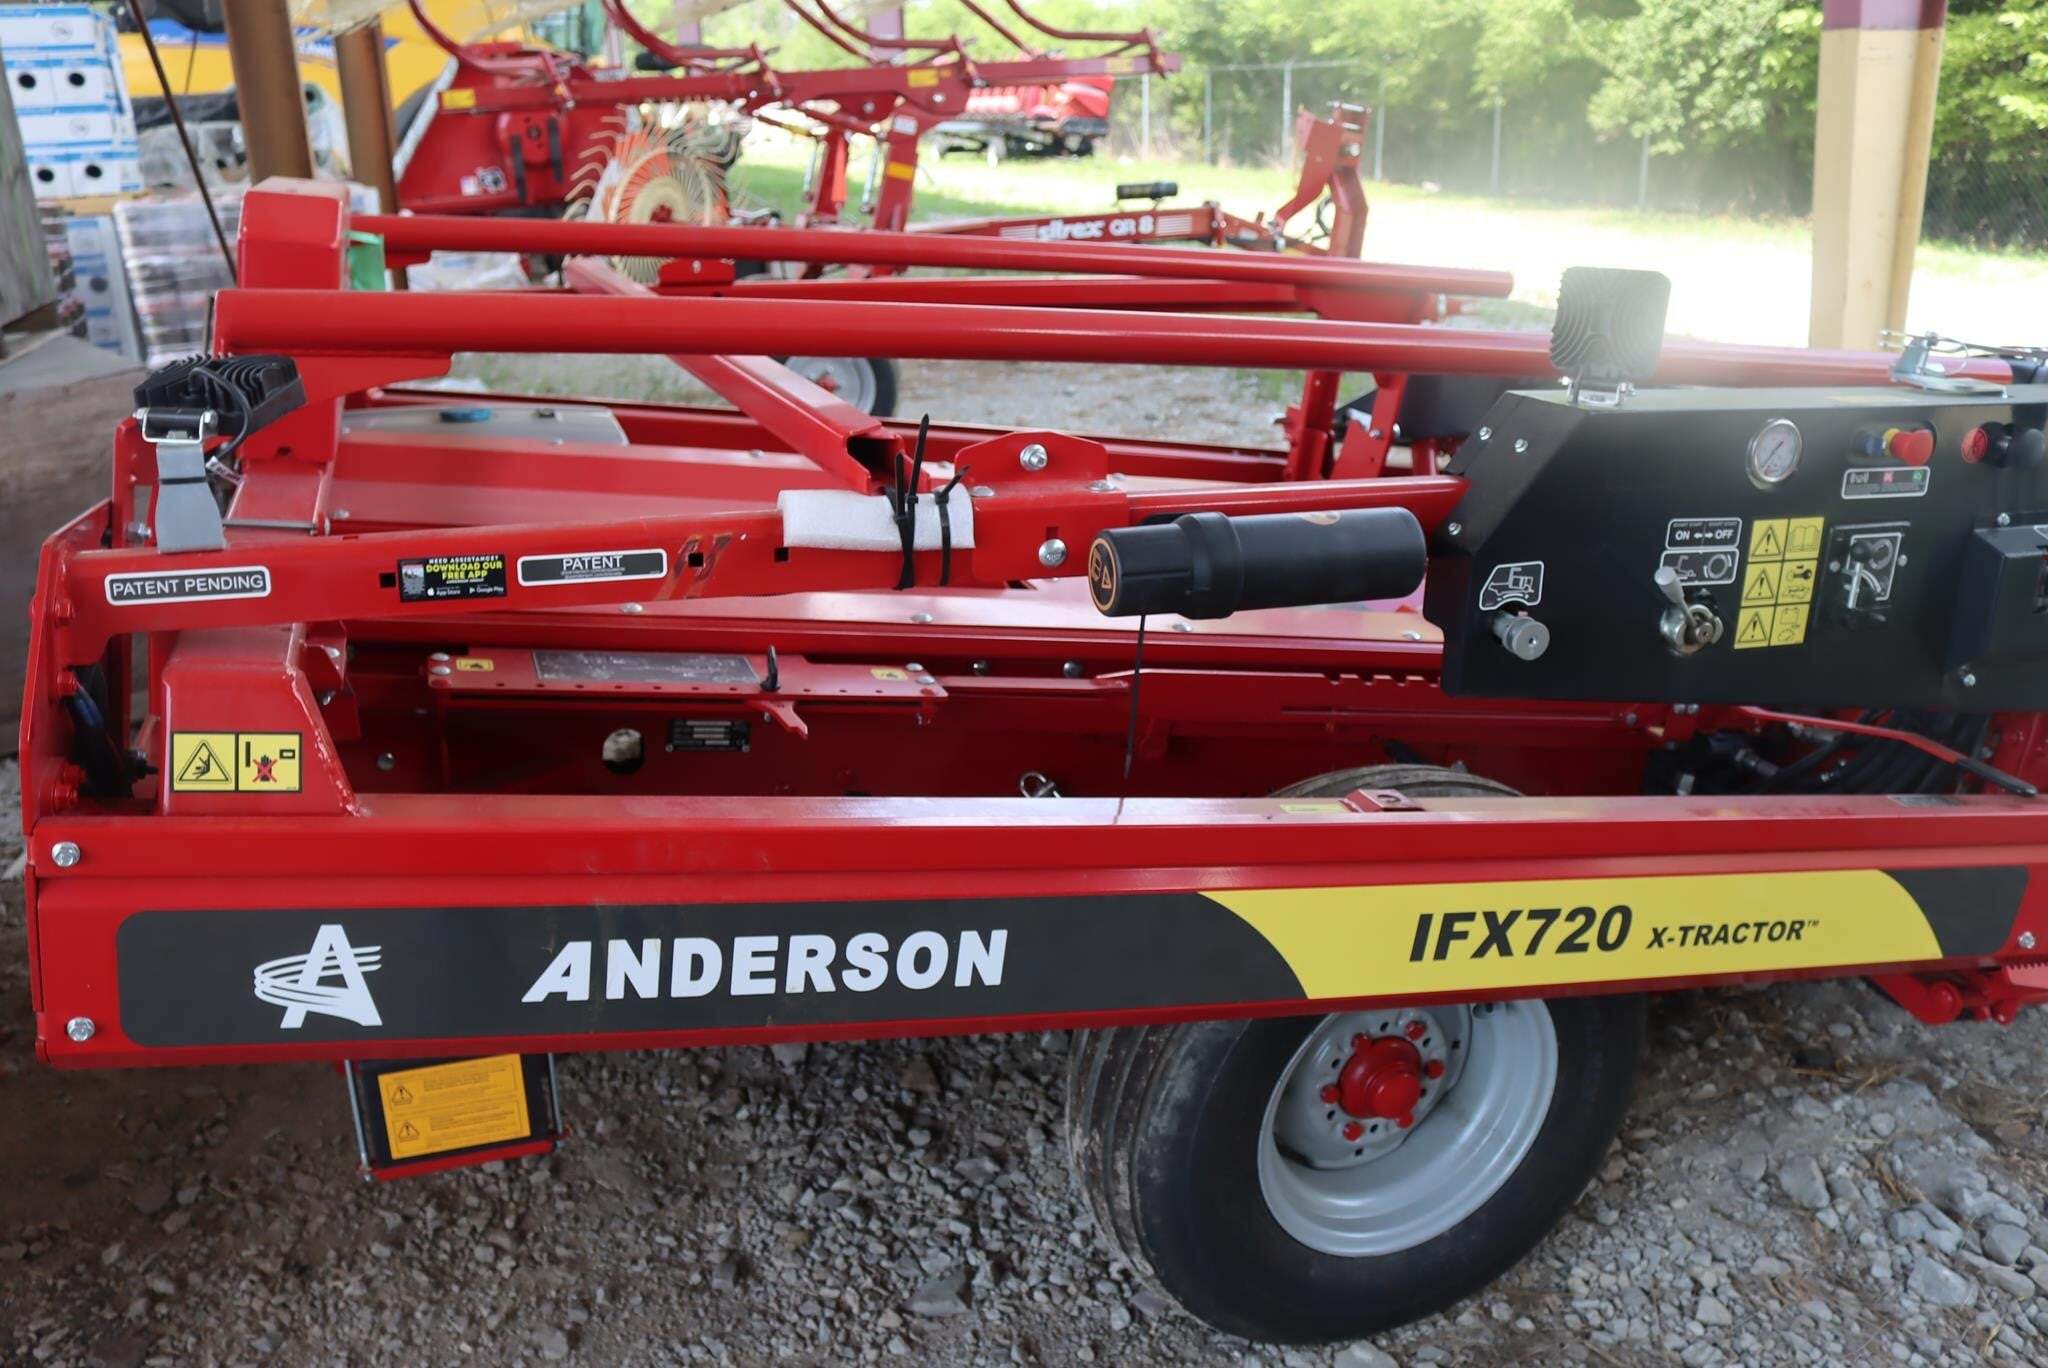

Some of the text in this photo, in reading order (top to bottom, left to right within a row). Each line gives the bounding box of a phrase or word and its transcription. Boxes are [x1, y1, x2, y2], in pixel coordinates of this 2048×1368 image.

[1675, 529, 1734, 541] ON OFF
[425, 560, 503, 573] DOWNLOAD OUR
[562, 555, 624, 571] PATENT
[441, 569, 489, 580] FREE APP
[112, 574, 265, 597] PATENT PENDING
[1408, 904, 1633, 963] IFX720
[521, 928, 1008, 1003] ANDERSON
